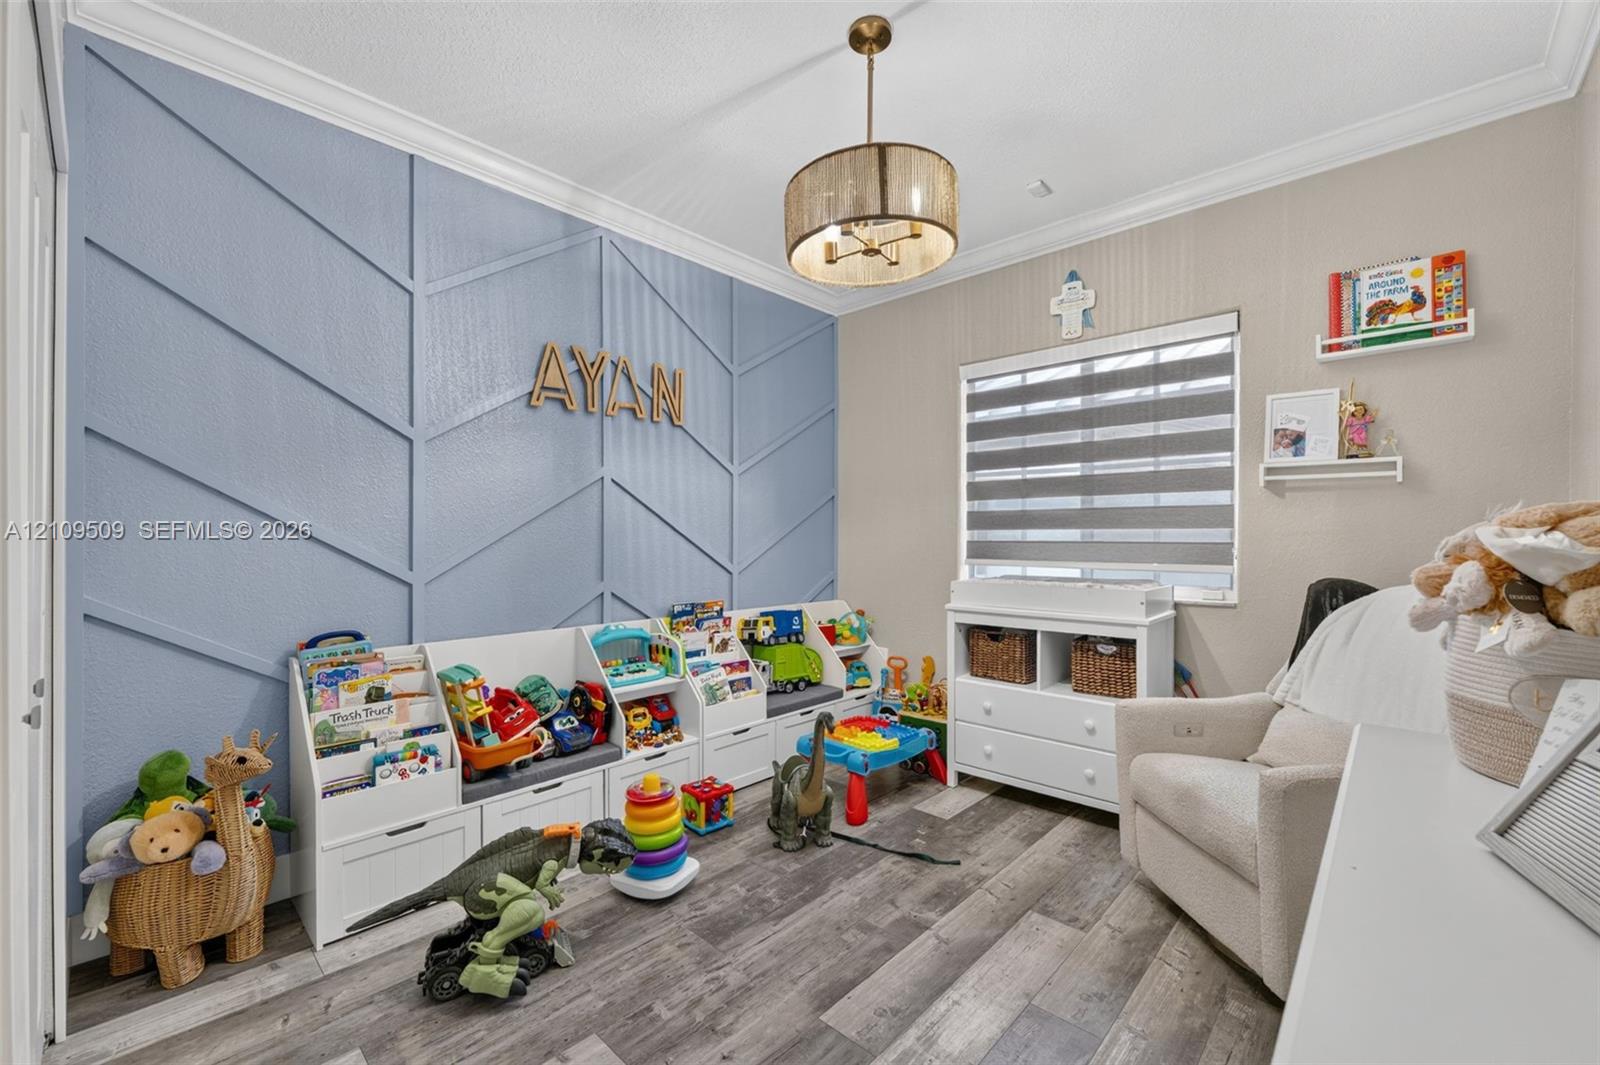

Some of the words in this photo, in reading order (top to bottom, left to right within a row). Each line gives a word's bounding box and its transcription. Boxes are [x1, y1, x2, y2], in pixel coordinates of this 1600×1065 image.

[1368, 277, 1406, 290] AROUND
[1366, 290, 1381, 300] THE
[1383, 285, 1409, 297] FARM
[529, 341, 687, 426] AYAN
[329, 710, 362, 724] Trash
[362, 704, 394, 718] Truck
